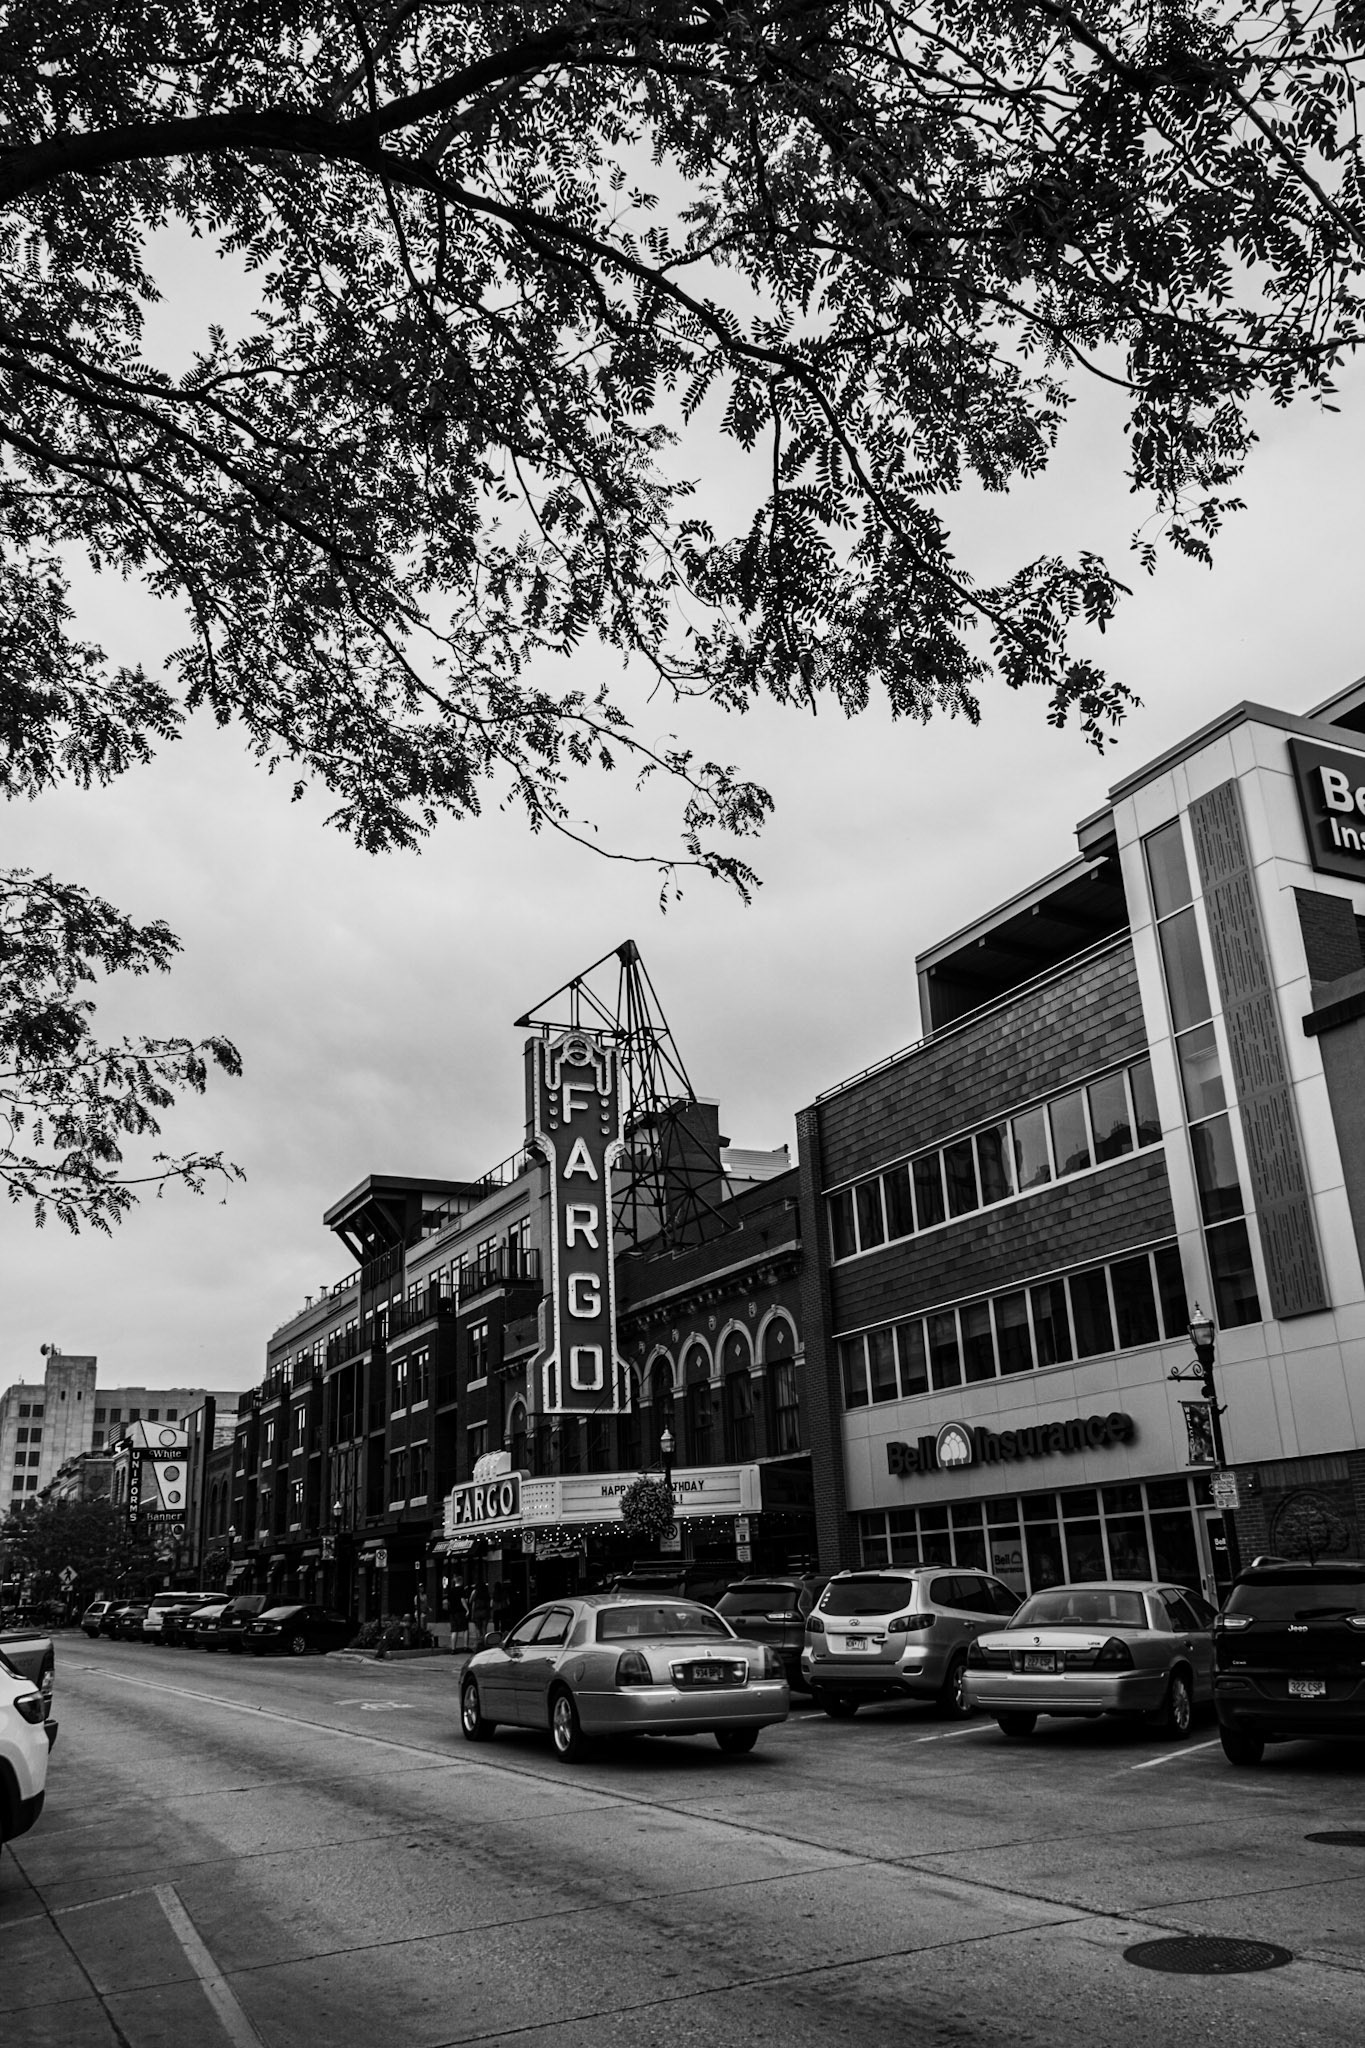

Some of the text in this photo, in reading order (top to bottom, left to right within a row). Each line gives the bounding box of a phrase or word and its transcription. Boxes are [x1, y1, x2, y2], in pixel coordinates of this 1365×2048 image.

[562, 1081, 604, 1391] FARGO
[149, 1450, 182, 1459] White
[887, 1411, 1133, 1475] Bell Insurance
[130, 1451, 141, 1522] UNIFORMS
[453, 1481, 513, 1524] FARGO
[146, 1512, 183, 1522] Banner
[995, 1554, 1010, 1565] Bell
[1288, 1624, 1308, 1632] Jeep
